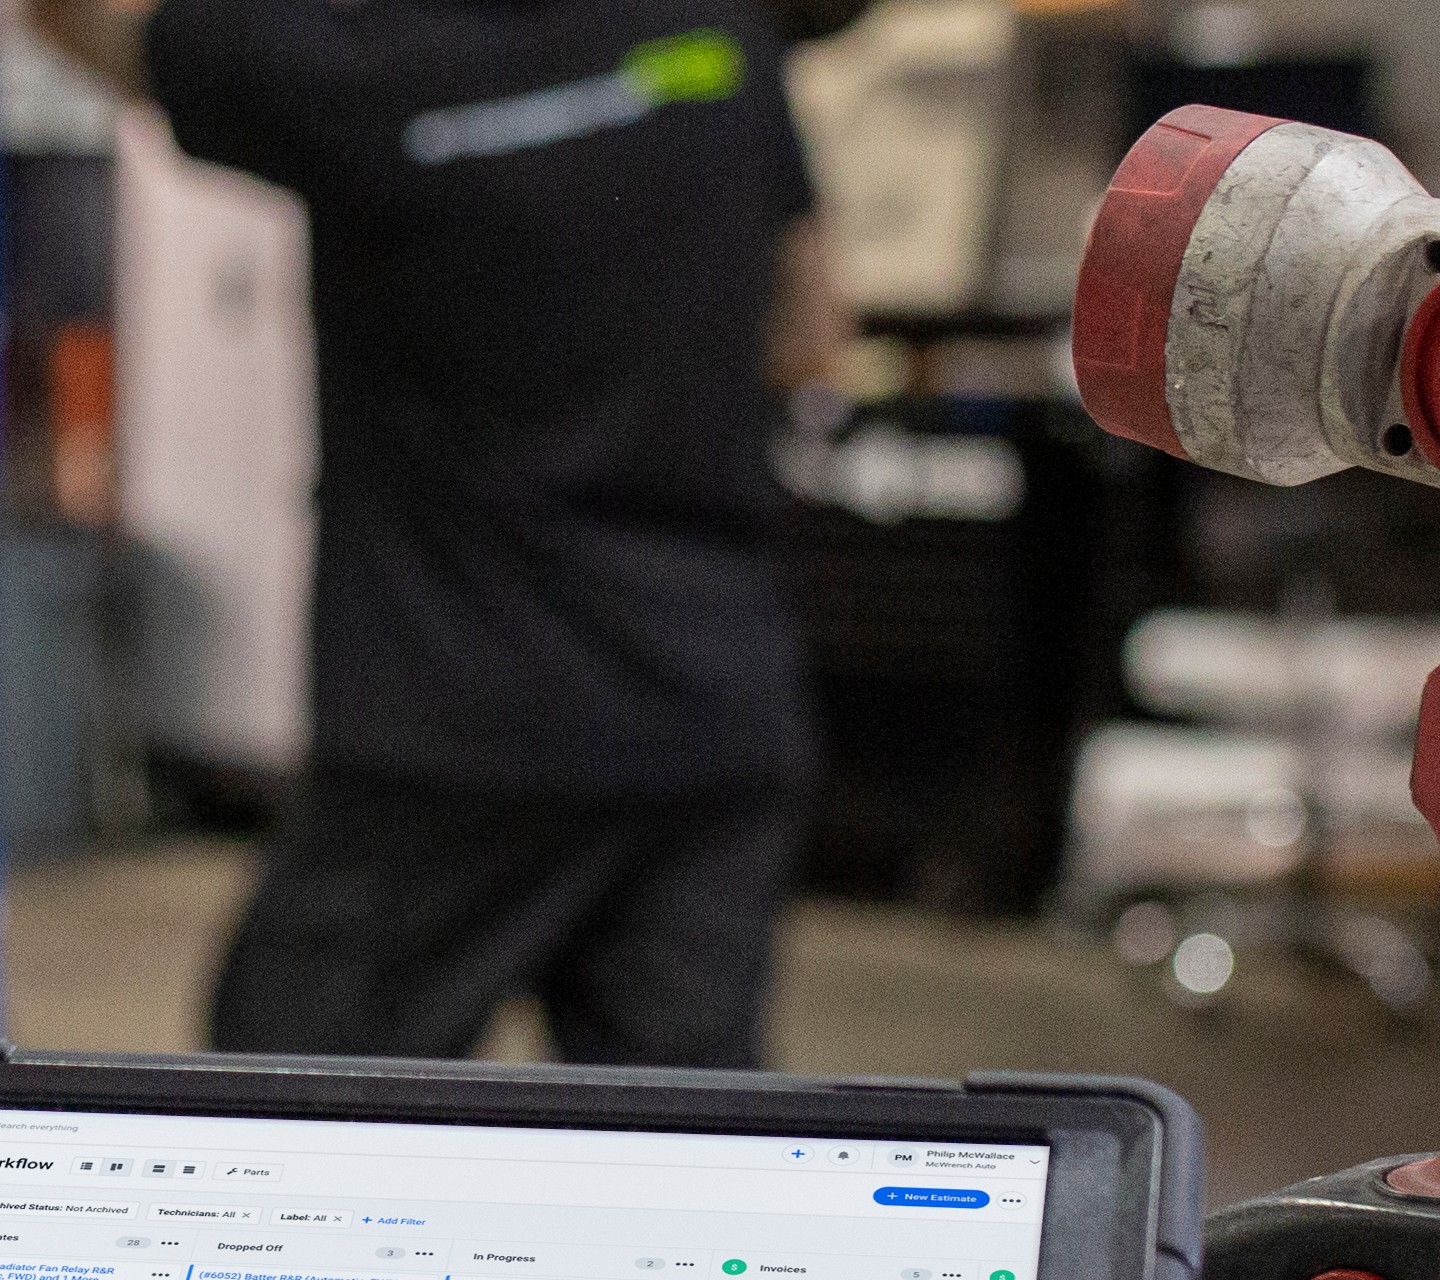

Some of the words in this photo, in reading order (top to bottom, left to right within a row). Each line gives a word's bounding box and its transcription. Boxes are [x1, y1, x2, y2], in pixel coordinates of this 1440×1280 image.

[28, 1124, 79, 1133] everything
[892, 1153, 913, 1161] PM
[926, 1149, 956, 1159] Philip
[957, 1151, 1015, 1161] McWallace
[925, 1160, 973, 1169] McWrench
[242, 1168, 270, 1176] Parts
[904, 1193, 928, 1201] New
[930, 1193, 977, 1203] Estimate
[27, 1203, 63, 1211] Status:
[64, 1204, 84, 1212] Not
[85, 1205, 129, 1214] Archived
[158, 1208, 219, 1217] Technicians:
[279, 1213, 310, 1221] Label:
[312, 1214, 327, 1222] All
[376, 1217, 399, 1225] Add
[399, 1217, 426, 1226] Filter
[217, 1242, 264, 1252] Dropped
[265, 1244, 284, 1252] Off
[472, 1252, 484, 1260] In
[485, 1253, 536, 1263] Progress
[38, 1264, 59, 1272] Fan
[60, 1265, 90, 1276] Relay
[91, 1266, 115, 1275] R&R
[759, 1264, 807, 1274] Invoices
[243, 1272, 277, 1280] Batter
